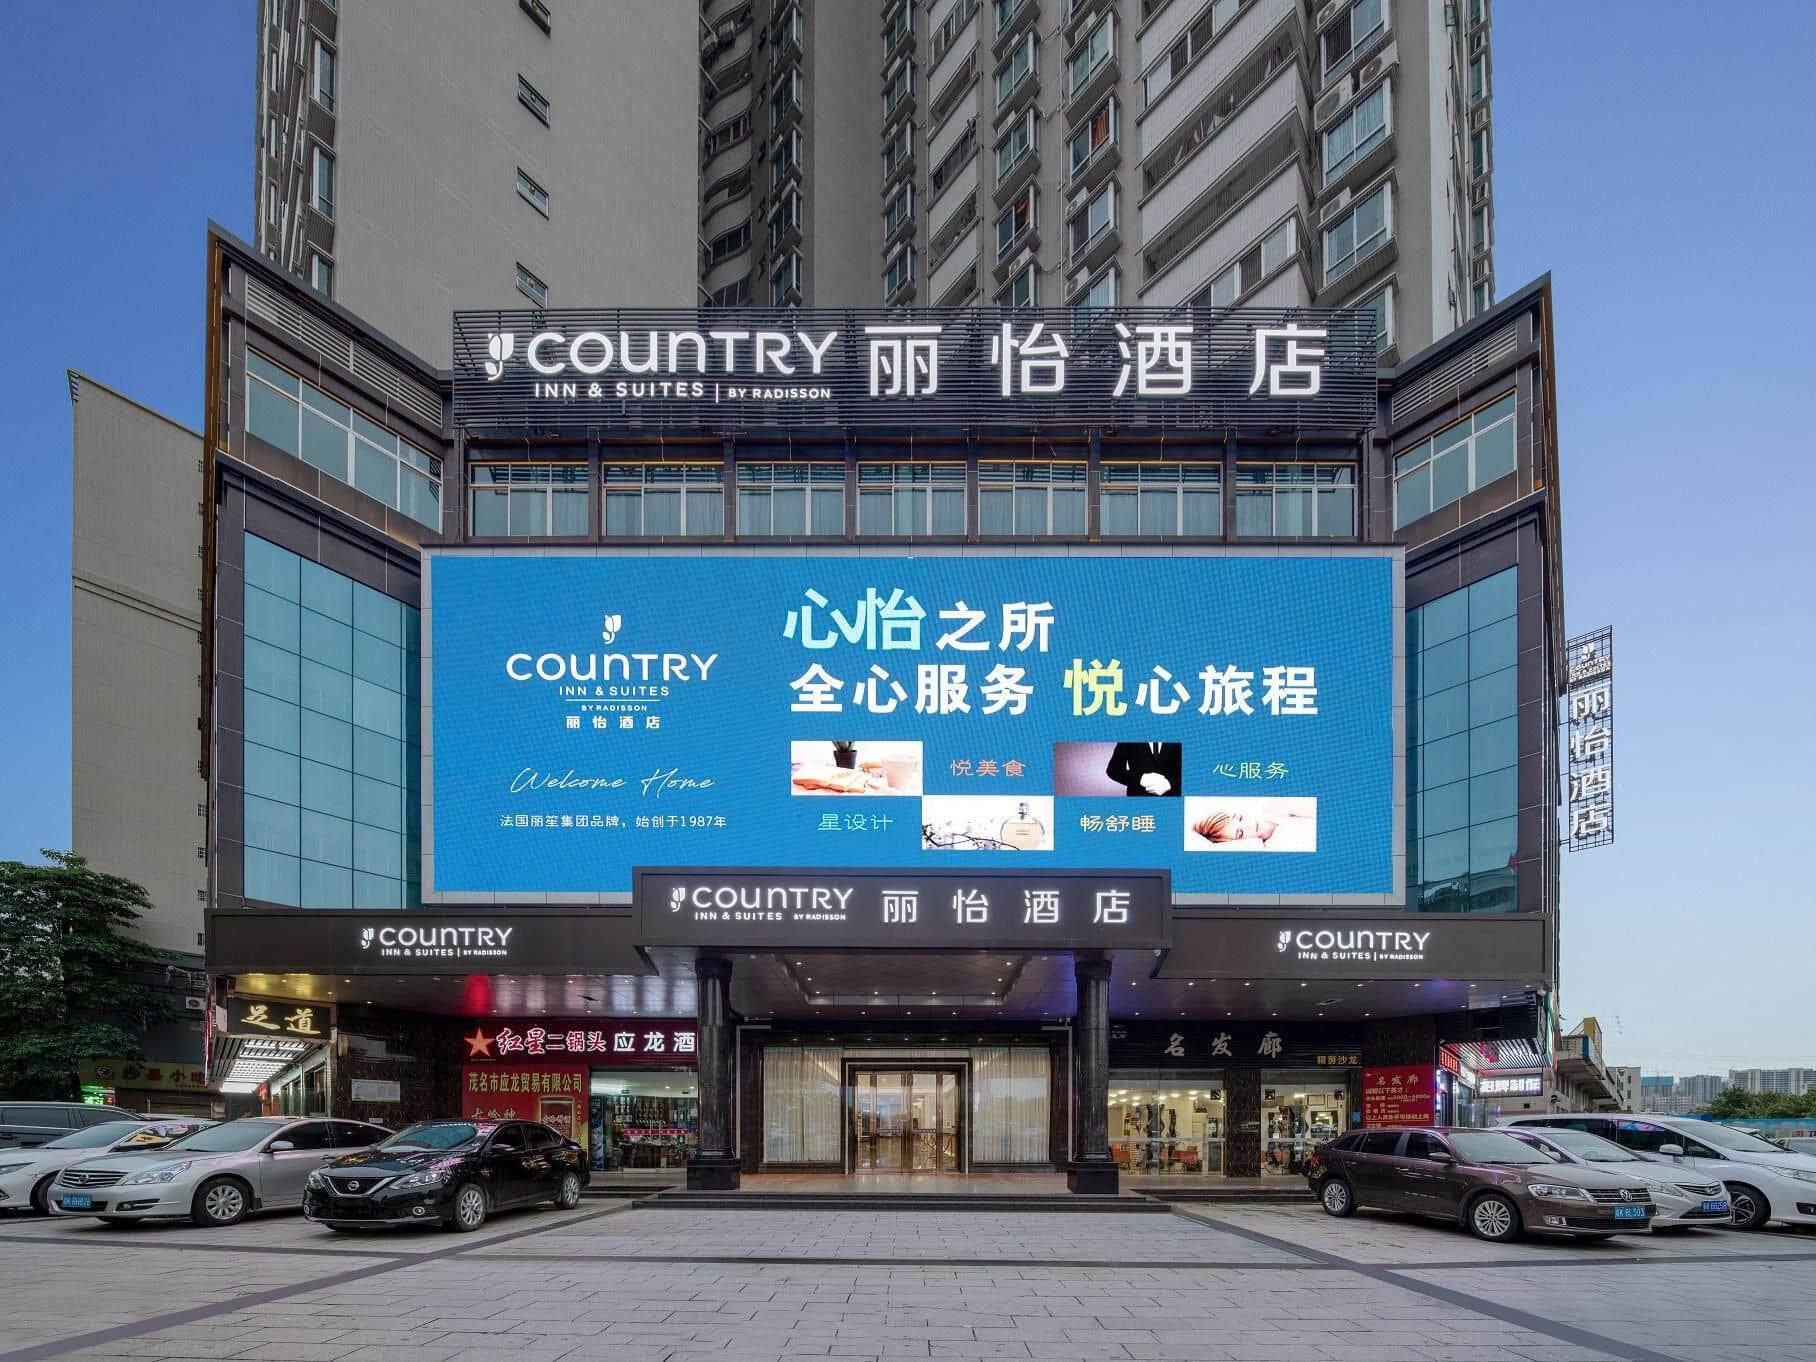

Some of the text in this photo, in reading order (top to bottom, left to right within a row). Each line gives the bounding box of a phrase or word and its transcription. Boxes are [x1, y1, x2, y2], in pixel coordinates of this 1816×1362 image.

[861, 322, 1329, 397] 丽怡酒店
[535, 381, 831, 400] INN & SUITES BY RADISSON
[783, 587, 1055, 653] 心怡之所
[559, 685, 670, 697] INN & SUITES
[789, 658, 1319, 716] 全心服务 悦心旅程
[565, 715, 661, 729] 丽怡酒店
[949, 759, 1026, 777] 悦美食
[1570, 681, 1612, 839] 丽怡酒店
[1212, 761, 1289, 780] 心服务
[510, 767, 715, 799] Welcome Home
[817, 813, 894, 832] 星设计
[1080, 814, 1157, 833] 畅舒睡
[881, 888, 1131, 924] 丽怡酒店
[694, 911, 718, 921] INN
[721, 911, 730, 921] &
[735, 911, 783, 921] SUITES
[381, 948, 401, 956] INN
[403, 948, 412, 956] &
[415, 948, 454, 957] SUITES
[1298, 951, 1318, 960] INN
[1332, 951, 1371, 960] SUITES
[496, 1027, 606, 1055] 红星二锅头
[1164, 1032, 1284, 1059] 名发廊
[469, 1072, 582, 1093] 茂名市应龙贸易有限公司
